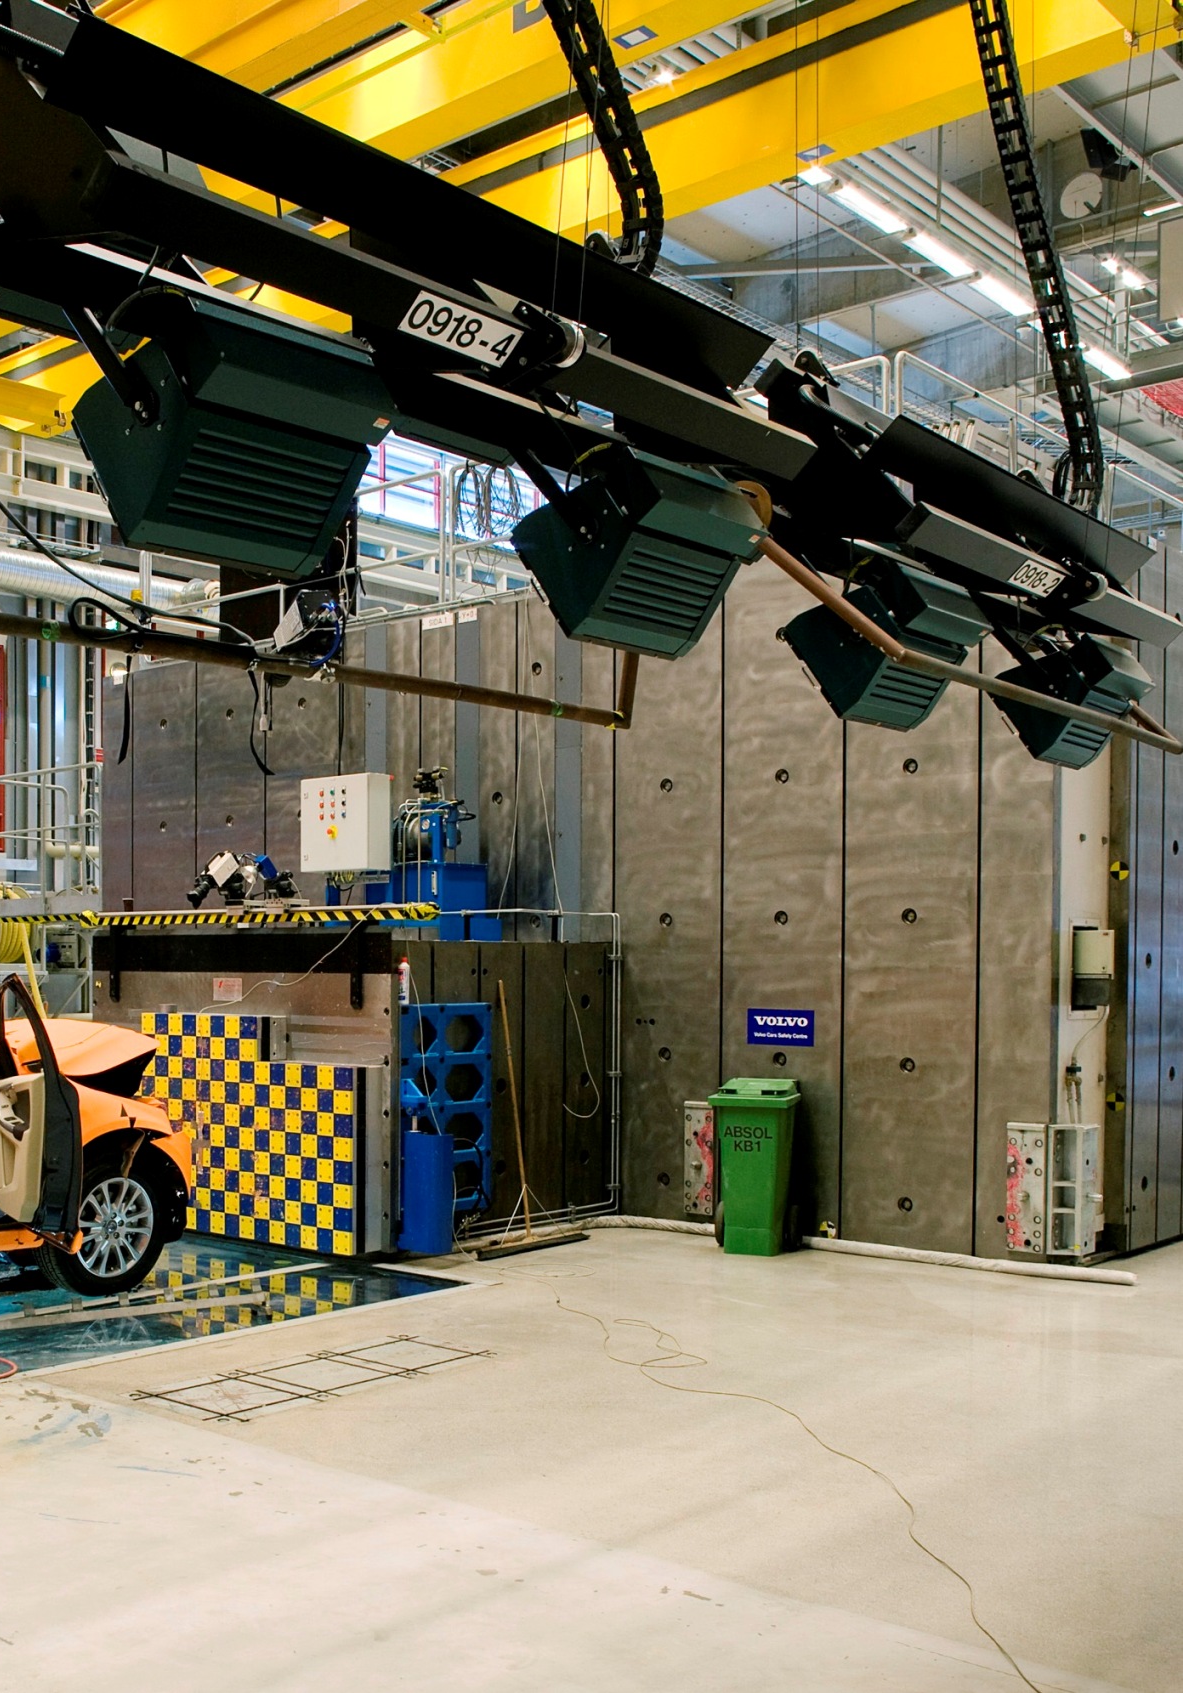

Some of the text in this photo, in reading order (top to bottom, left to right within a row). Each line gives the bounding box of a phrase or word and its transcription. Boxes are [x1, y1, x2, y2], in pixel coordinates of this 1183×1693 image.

[407, 299, 516, 361] 0918-4
[1013, 564, 1061, 594] 0918-2
[754, 1015, 808, 1027] VOLVO
[724, 1126, 773, 1139] ABSOL
[734, 1140, 761, 1152] KB1
